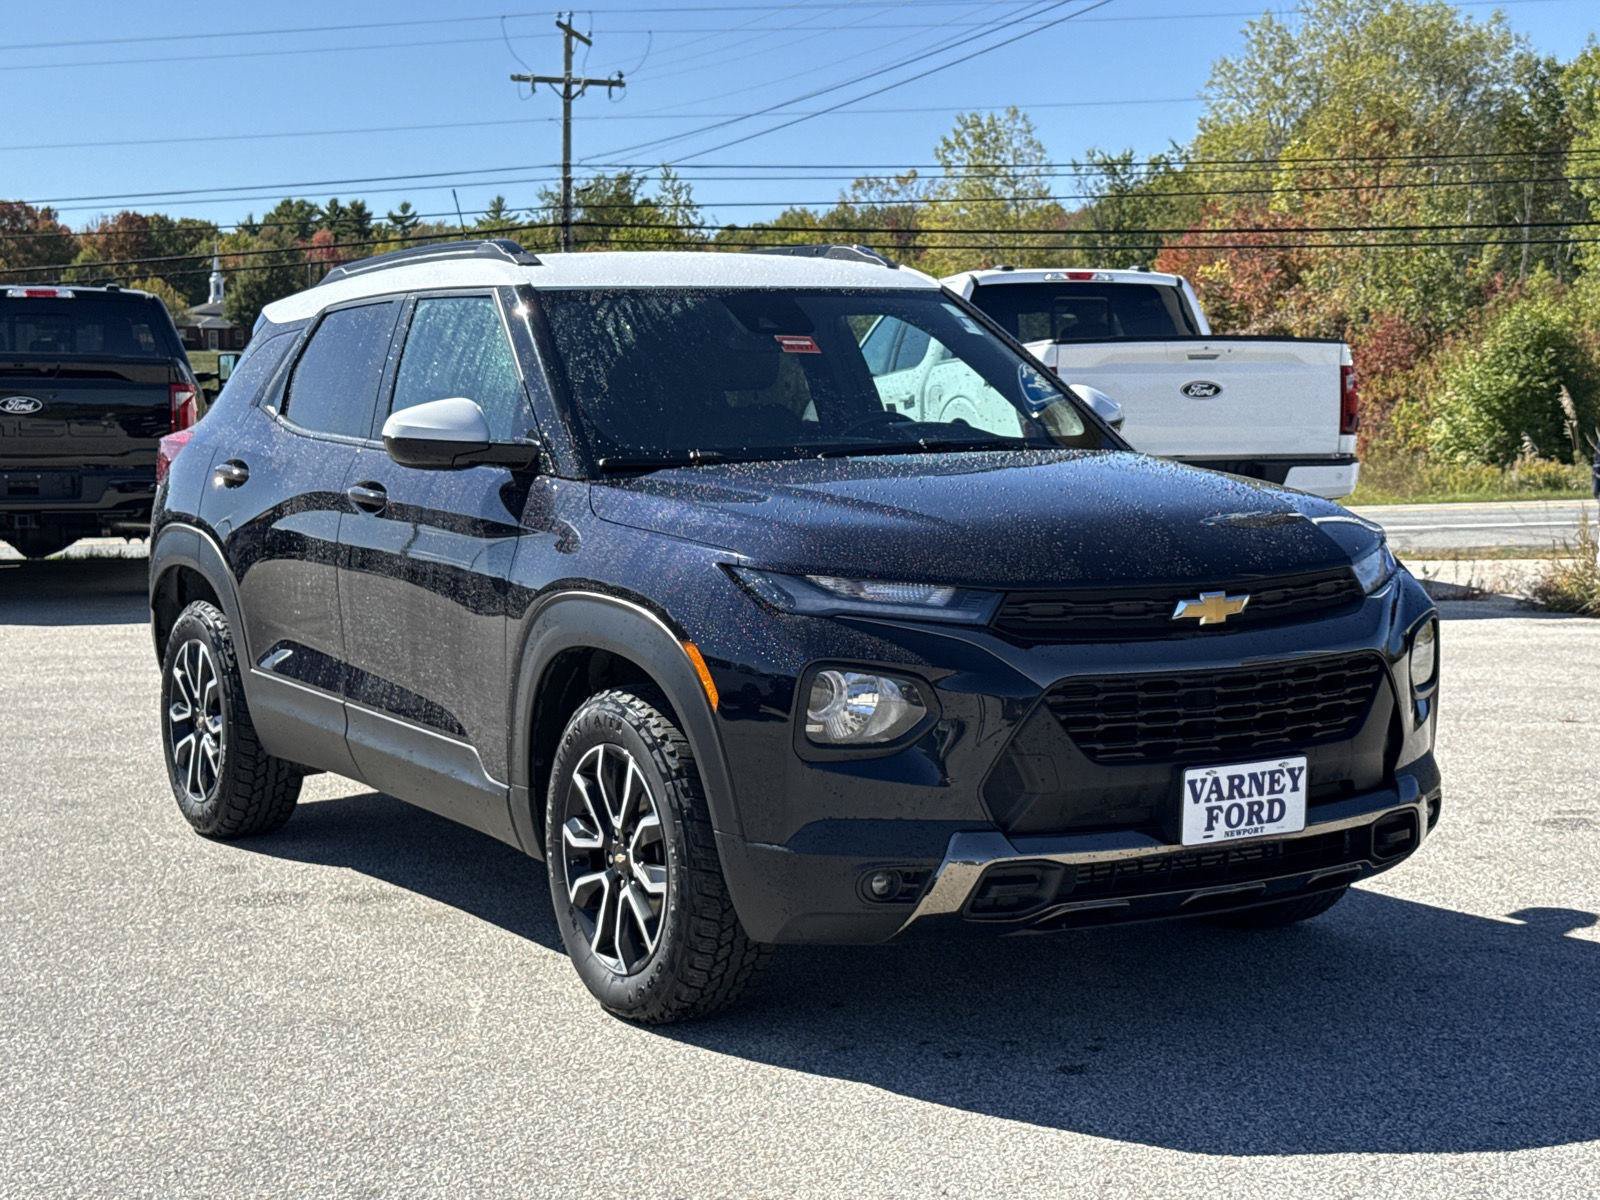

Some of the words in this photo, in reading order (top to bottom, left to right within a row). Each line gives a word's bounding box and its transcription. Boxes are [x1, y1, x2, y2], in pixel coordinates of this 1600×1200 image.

[1187, 766, 1305, 804] VARNEY
[1204, 798, 1286, 832] FORD
[1224, 826, 1265, 838] NEWPORT
